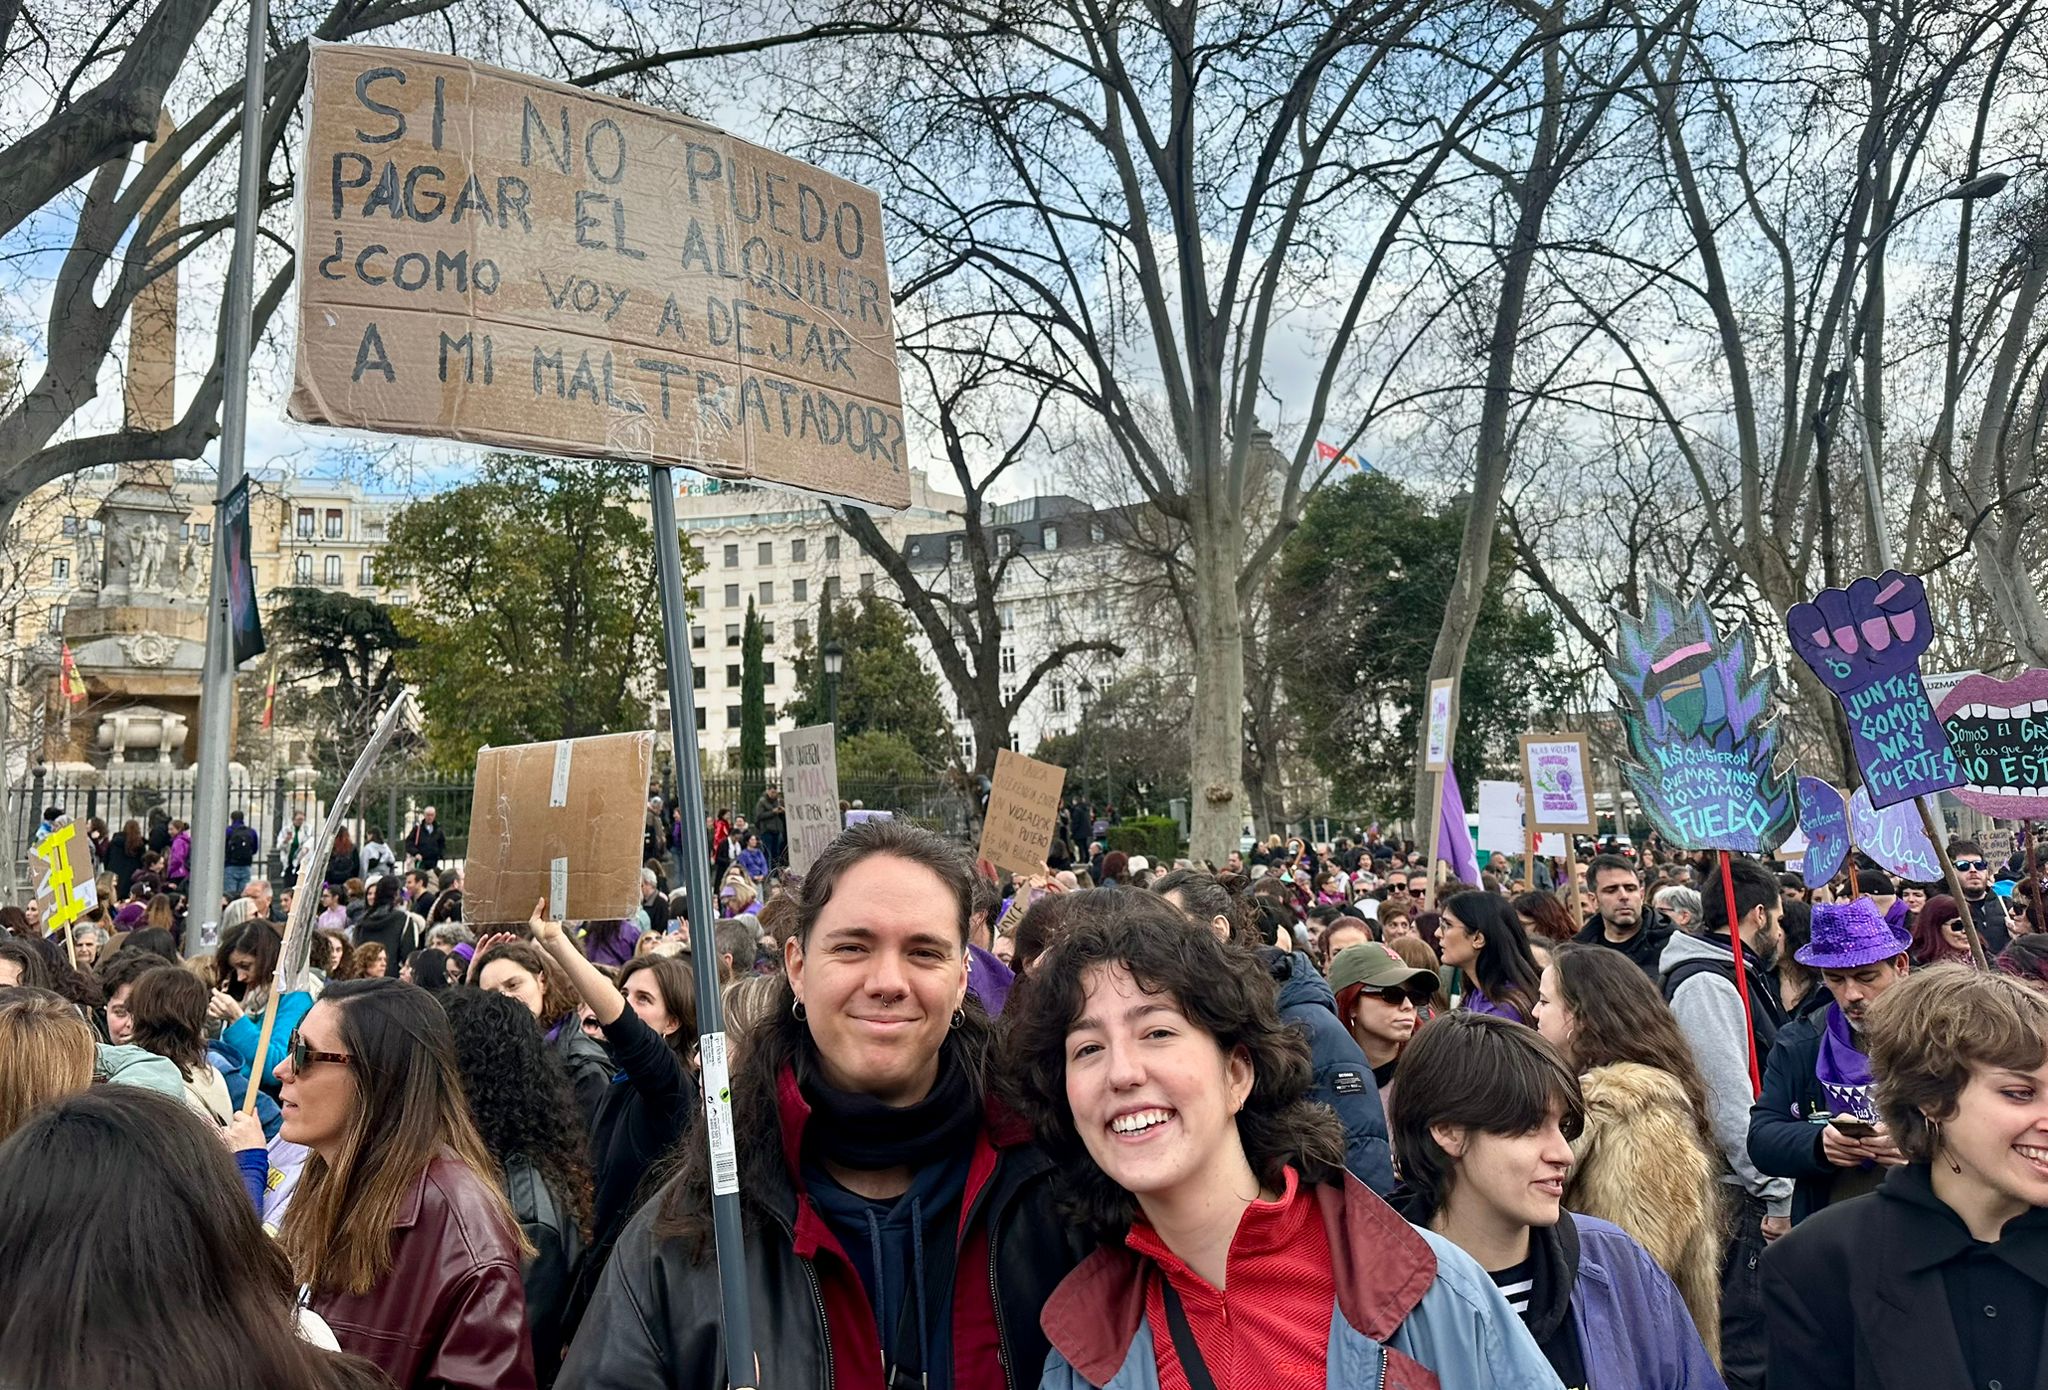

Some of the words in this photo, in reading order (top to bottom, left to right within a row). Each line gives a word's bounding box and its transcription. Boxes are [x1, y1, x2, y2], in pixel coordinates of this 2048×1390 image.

[354, 66, 445, 150] SI
[521, 96, 626, 184] NO
[684, 141, 864, 260] PUEDO
[331, 151, 532, 233] PAGAR
[574, 190, 648, 260] EL
[680, 216, 886, 328] ALQUILER
[539, 269, 630, 322] VOY
[656, 297, 686, 341] A
[707, 300, 858, 382] DEJAR
[351, 322, 396, 383] A
[438, 330, 493, 385] MI
[1848, 672, 1918, 721] JUNTAS
[1860, 696, 1930, 741] SOMOS
[1866, 746, 1957, 796] FUERTES
[1974, 743, 1998, 756] las
[2001, 745, 2024, 759] que
[1670, 800, 1770, 843] FUEGO
[1863, 818, 1941, 875] Alas
[1808, 833, 1841, 876] Miedo
